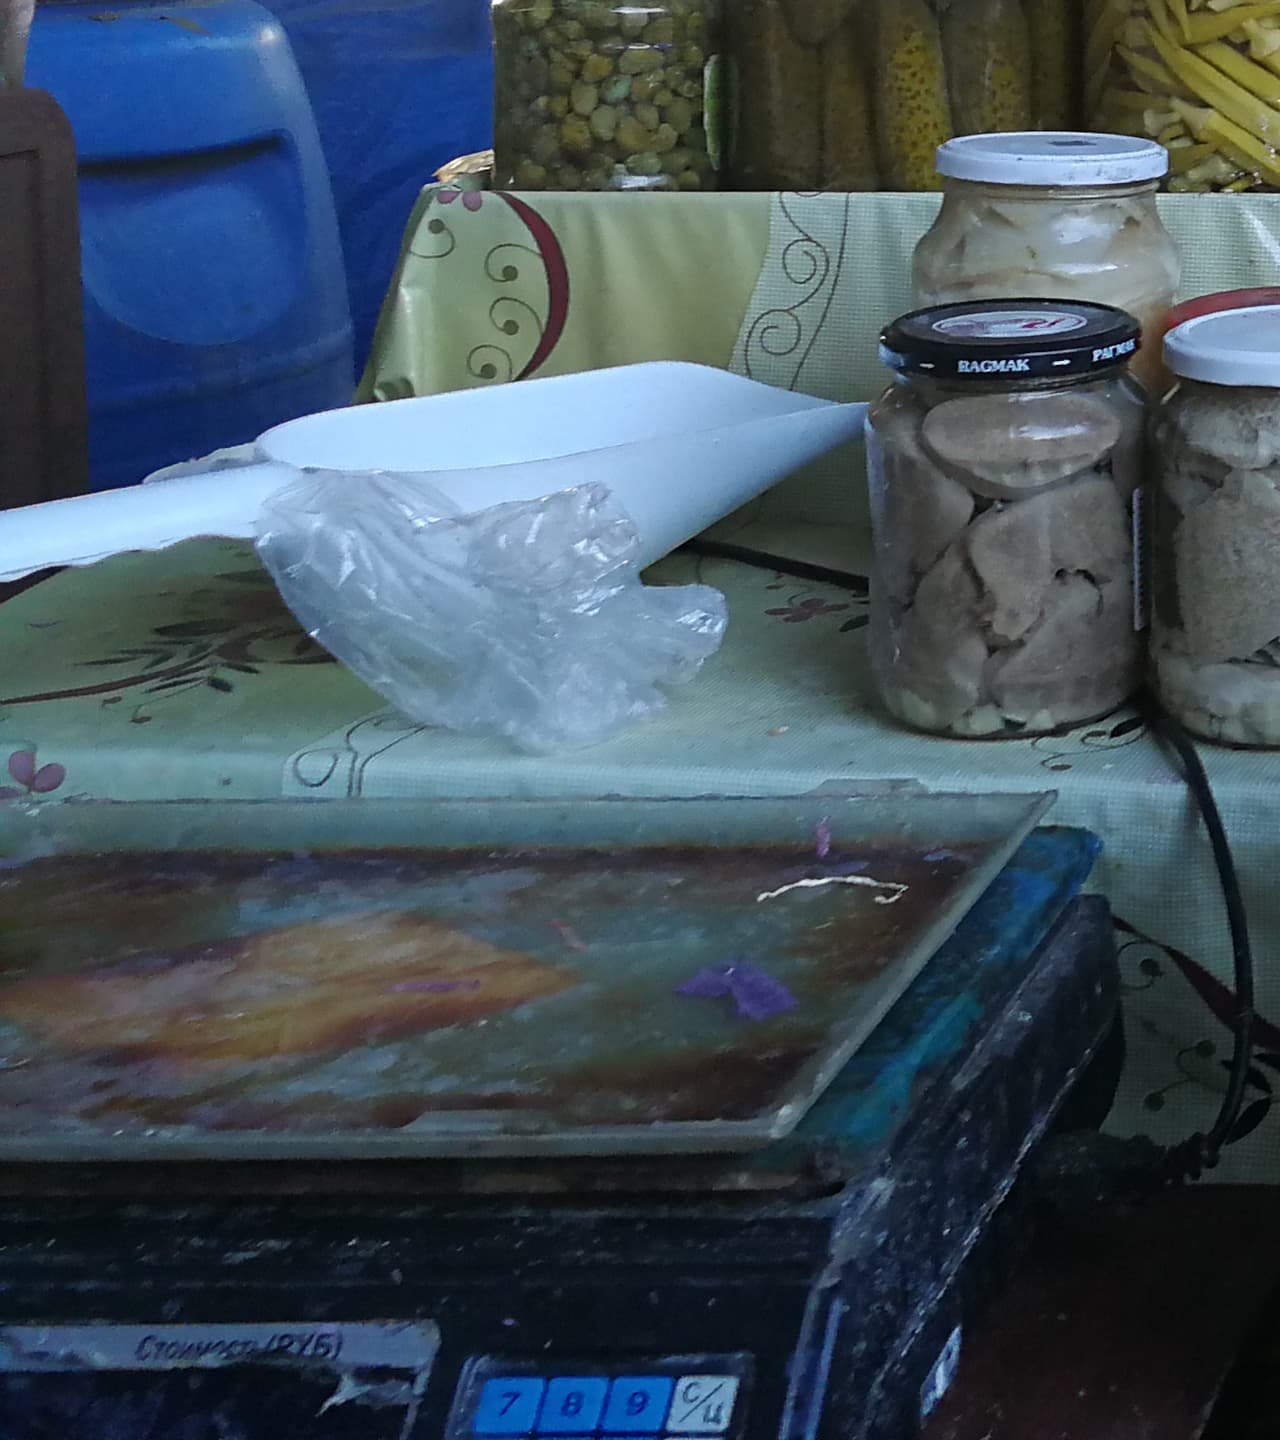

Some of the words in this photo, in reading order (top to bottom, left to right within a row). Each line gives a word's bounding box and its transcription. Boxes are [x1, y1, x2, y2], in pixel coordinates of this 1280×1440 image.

[498, 1392, 521, 1417] 7
[560, 1392, 585, 1417] 8
[625, 1392, 648, 1417] 9
